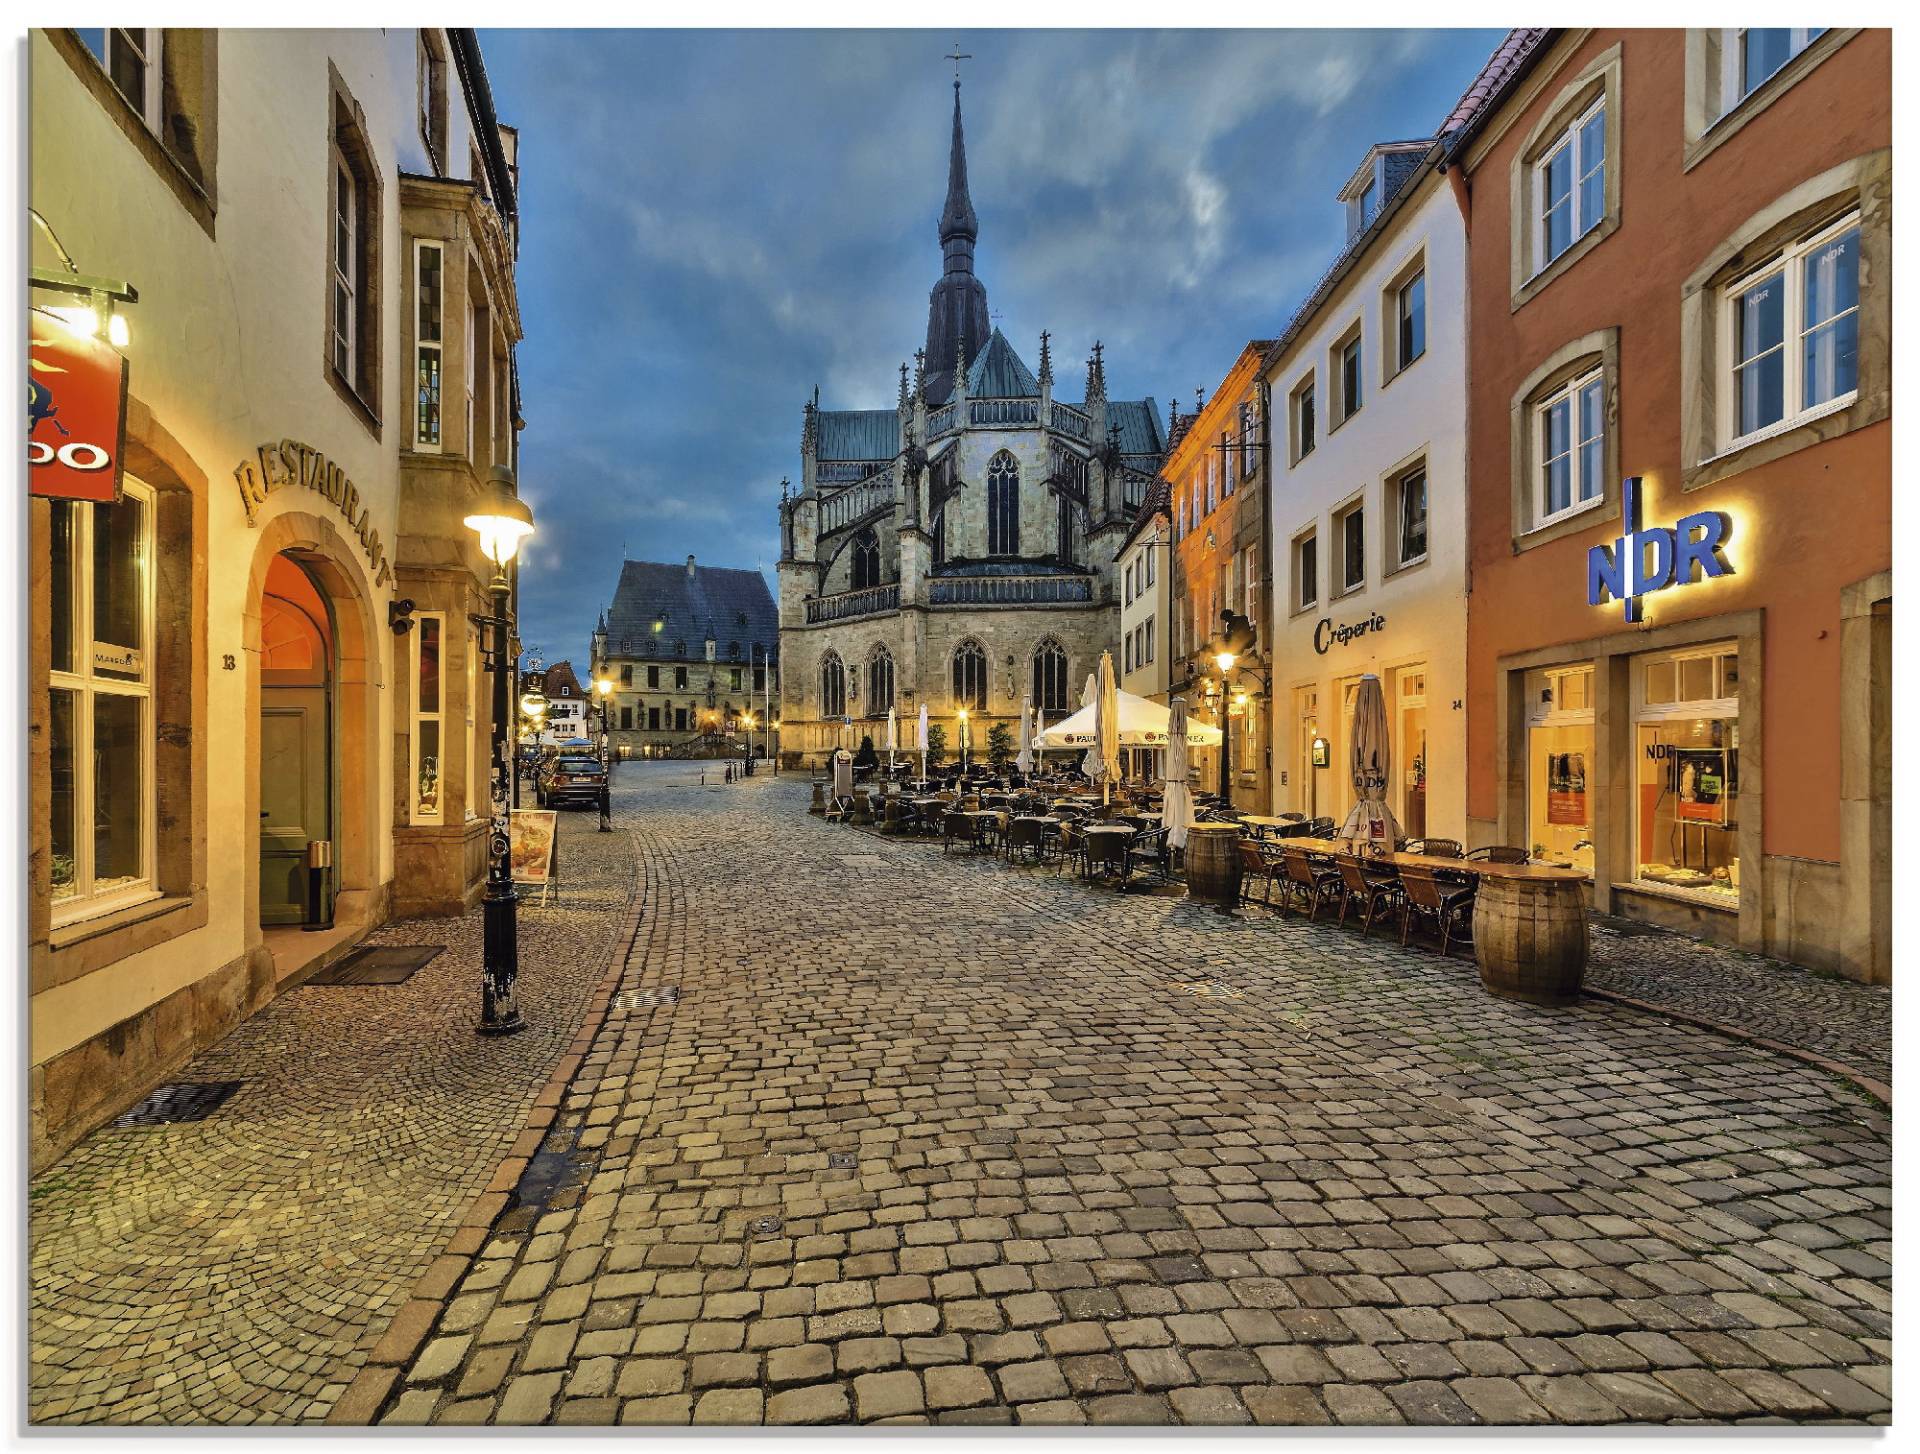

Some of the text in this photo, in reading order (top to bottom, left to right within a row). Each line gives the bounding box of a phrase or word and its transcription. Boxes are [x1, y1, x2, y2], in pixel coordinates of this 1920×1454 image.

[1821, 244, 1845, 265] NDR
[1748, 289, 1769, 307] NDR
[233, 438, 398, 591] RESTAURANT
[1588, 509, 1736, 607] NDR
[1313, 611, 1387, 655] Crêperie
[222, 654, 236, 671] 13
